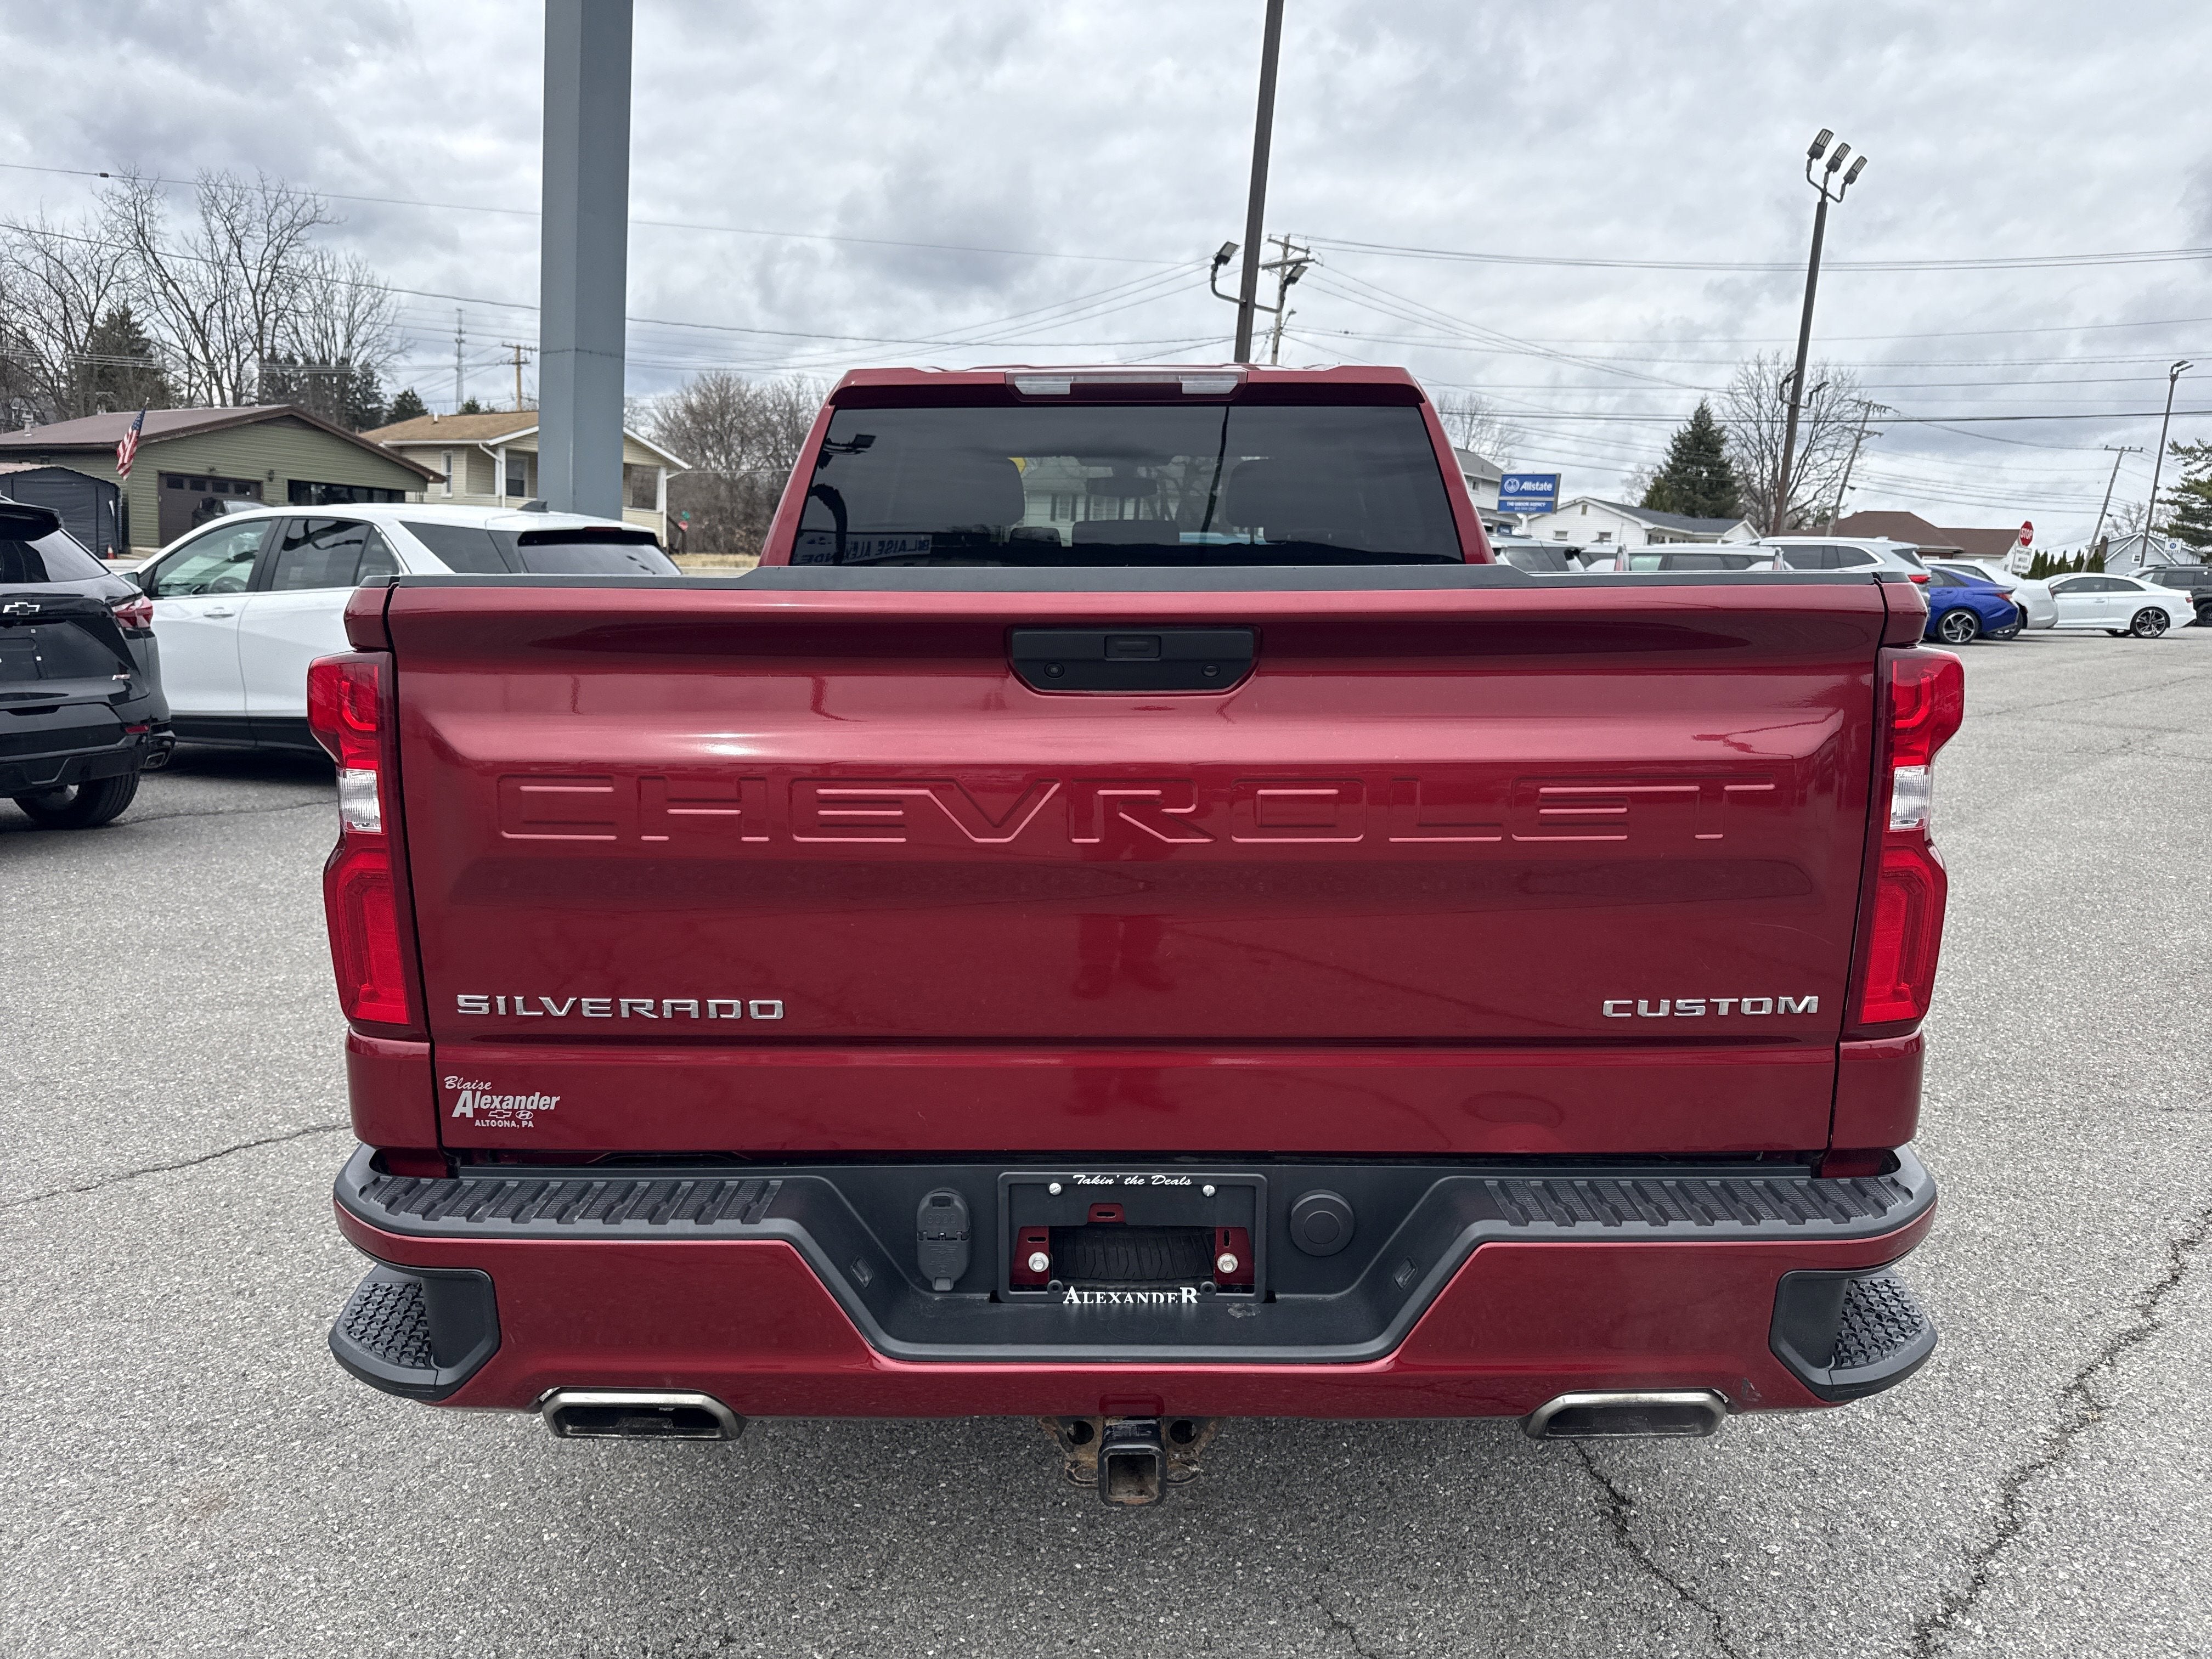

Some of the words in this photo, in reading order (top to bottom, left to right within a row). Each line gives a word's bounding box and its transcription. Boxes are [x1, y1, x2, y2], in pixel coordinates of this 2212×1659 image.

[1520, 481, 1552, 491] Allstate
[2021, 528, 2033, 539] STOP
[497, 773, 1775, 844] CHEVROLET
[457, 994, 784, 1019] SILVERADO
[1602, 996, 1819, 1017] CUSTOM
[444, 1075, 492, 1090] Blaise
[452, 1090, 561, 1118] Alexander
[475, 1119, 520, 1129] ALTOONA,
[1073, 1174, 1120, 1185] Takin'
[1124, 1175, 1146, 1185] the
[1151, 1175, 1192, 1186] Deals
